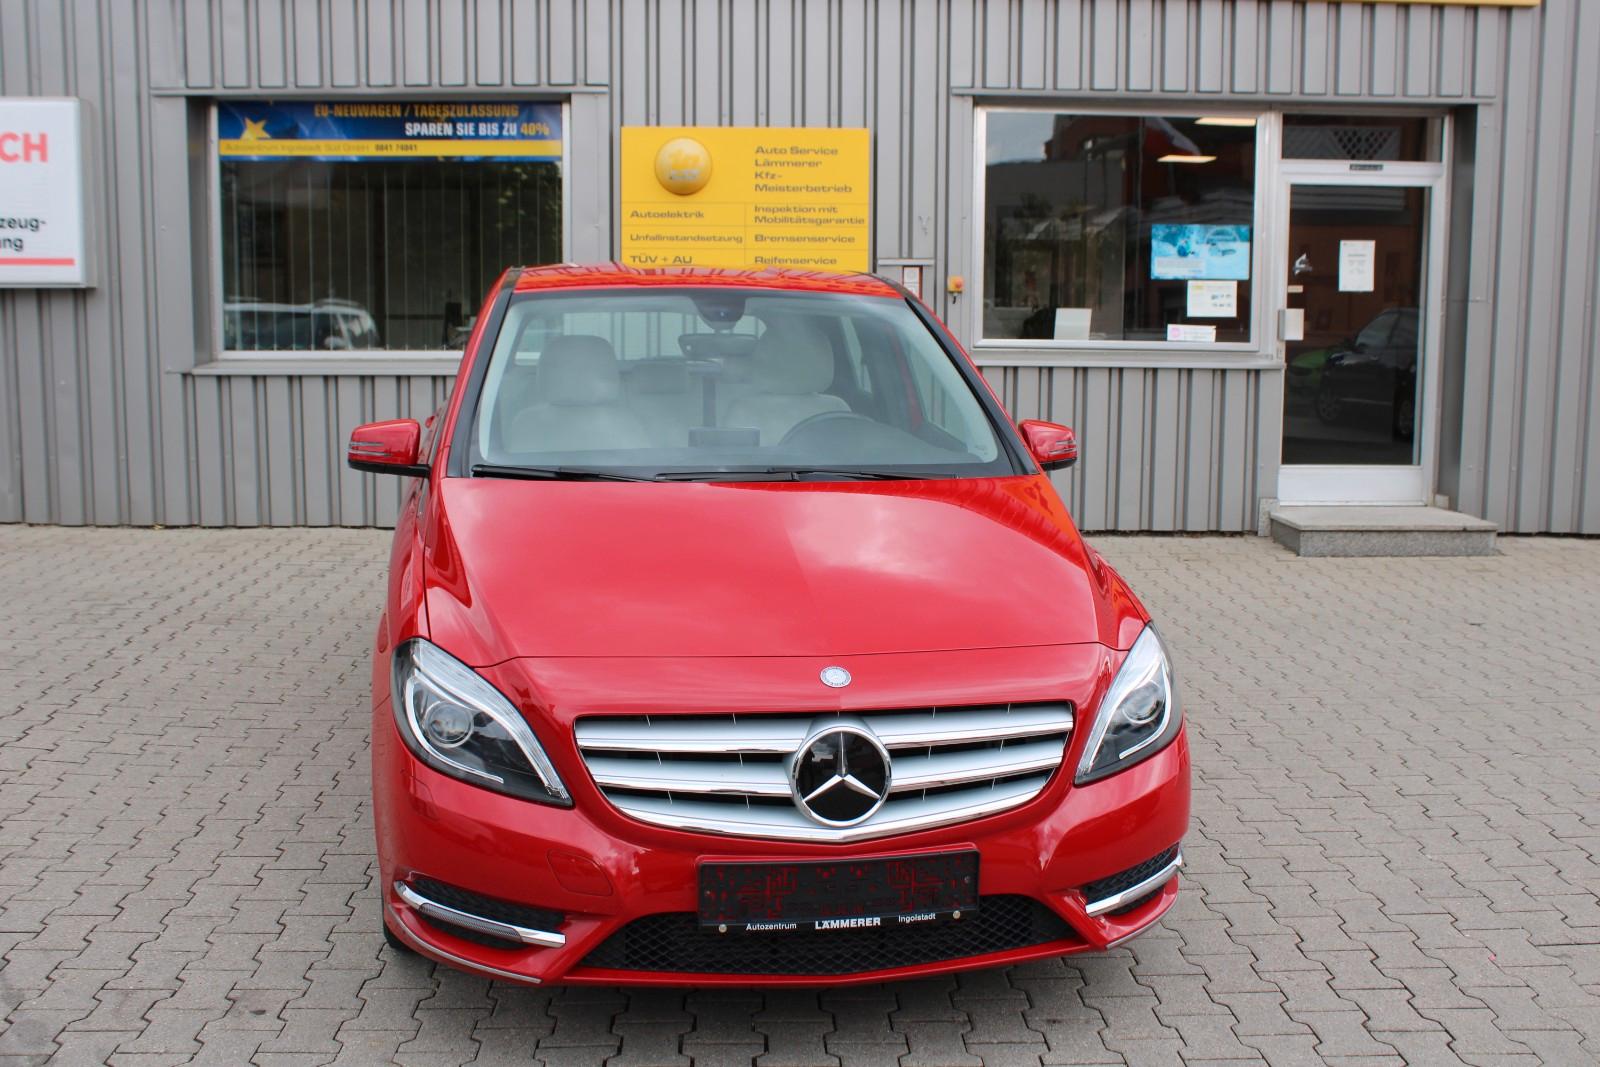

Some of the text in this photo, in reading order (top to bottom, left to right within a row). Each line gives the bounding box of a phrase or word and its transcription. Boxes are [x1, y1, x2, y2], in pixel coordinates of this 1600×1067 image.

[314, 104, 401, 117] EU-NEUWAGEN
[414, 104, 519, 117] TAGESZULASSUNG
[405, 122, 550, 136] SPAREN SIE BIS ZU 40%
[0, 132, 48, 162] CH
[755, 146, 838, 155] Auto Service
[755, 159, 822, 167] Lämmerer
[755, 171, 783, 179] Kfz-
[754, 184, 852, 192] Meisterbetrieb
[630, 210, 704, 218] Autoelektrik
[754, 206, 816, 214] Inspektion
[754, 216, 865, 225] Mobilitätsgarantie
[630, 234, 743, 244] Unfallinstandsetzung
[754, 234, 855, 243] Bremsenservice
[630, 252, 658, 263] TÜV
[672, 255, 693, 264] AU
[754, 256, 837, 264] Reifenservice
[746, 913, 936, 931] Autozentrum LÄMMERER Ingolstadt
